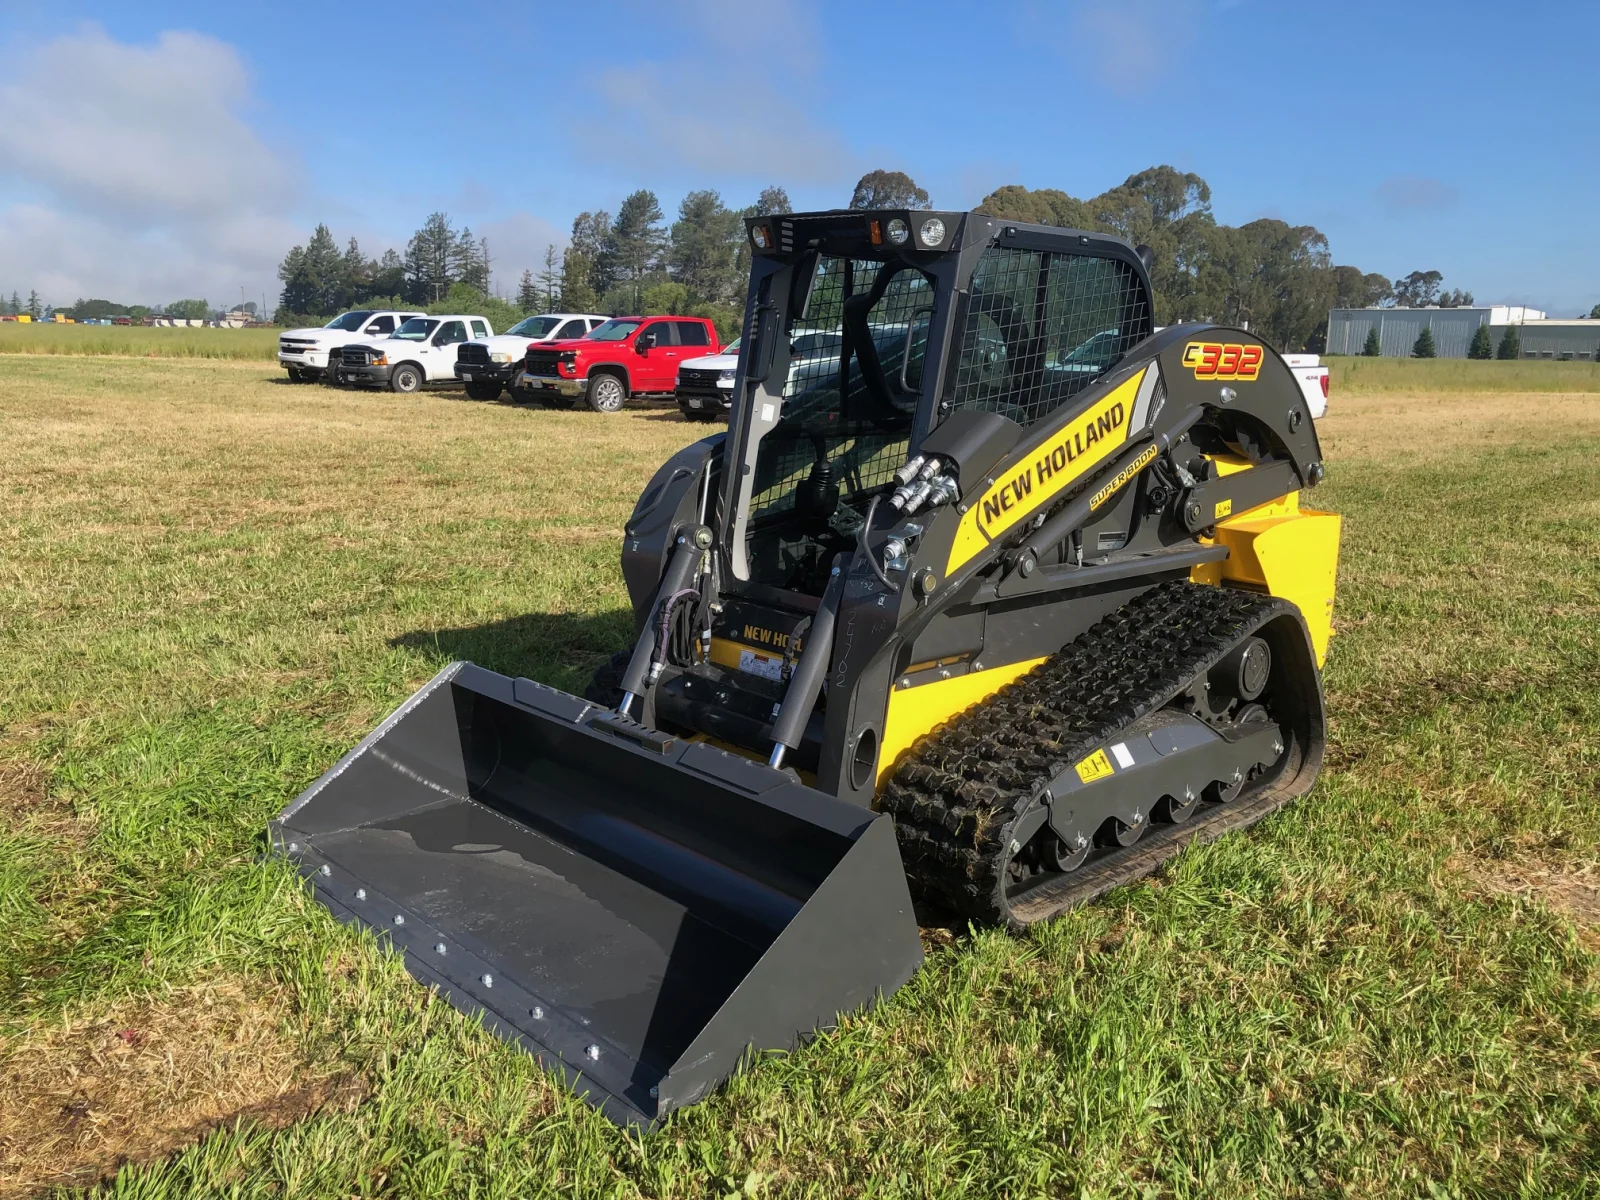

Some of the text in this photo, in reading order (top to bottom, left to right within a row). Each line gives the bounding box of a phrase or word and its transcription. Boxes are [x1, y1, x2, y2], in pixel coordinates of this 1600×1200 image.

[1183, 344, 1263, 377] C332
[983, 402, 1124, 525] NEW HOLLAND
[1090, 444, 1157, 509] SUPER BOOM
[743, 624, 772, 644] NEW
